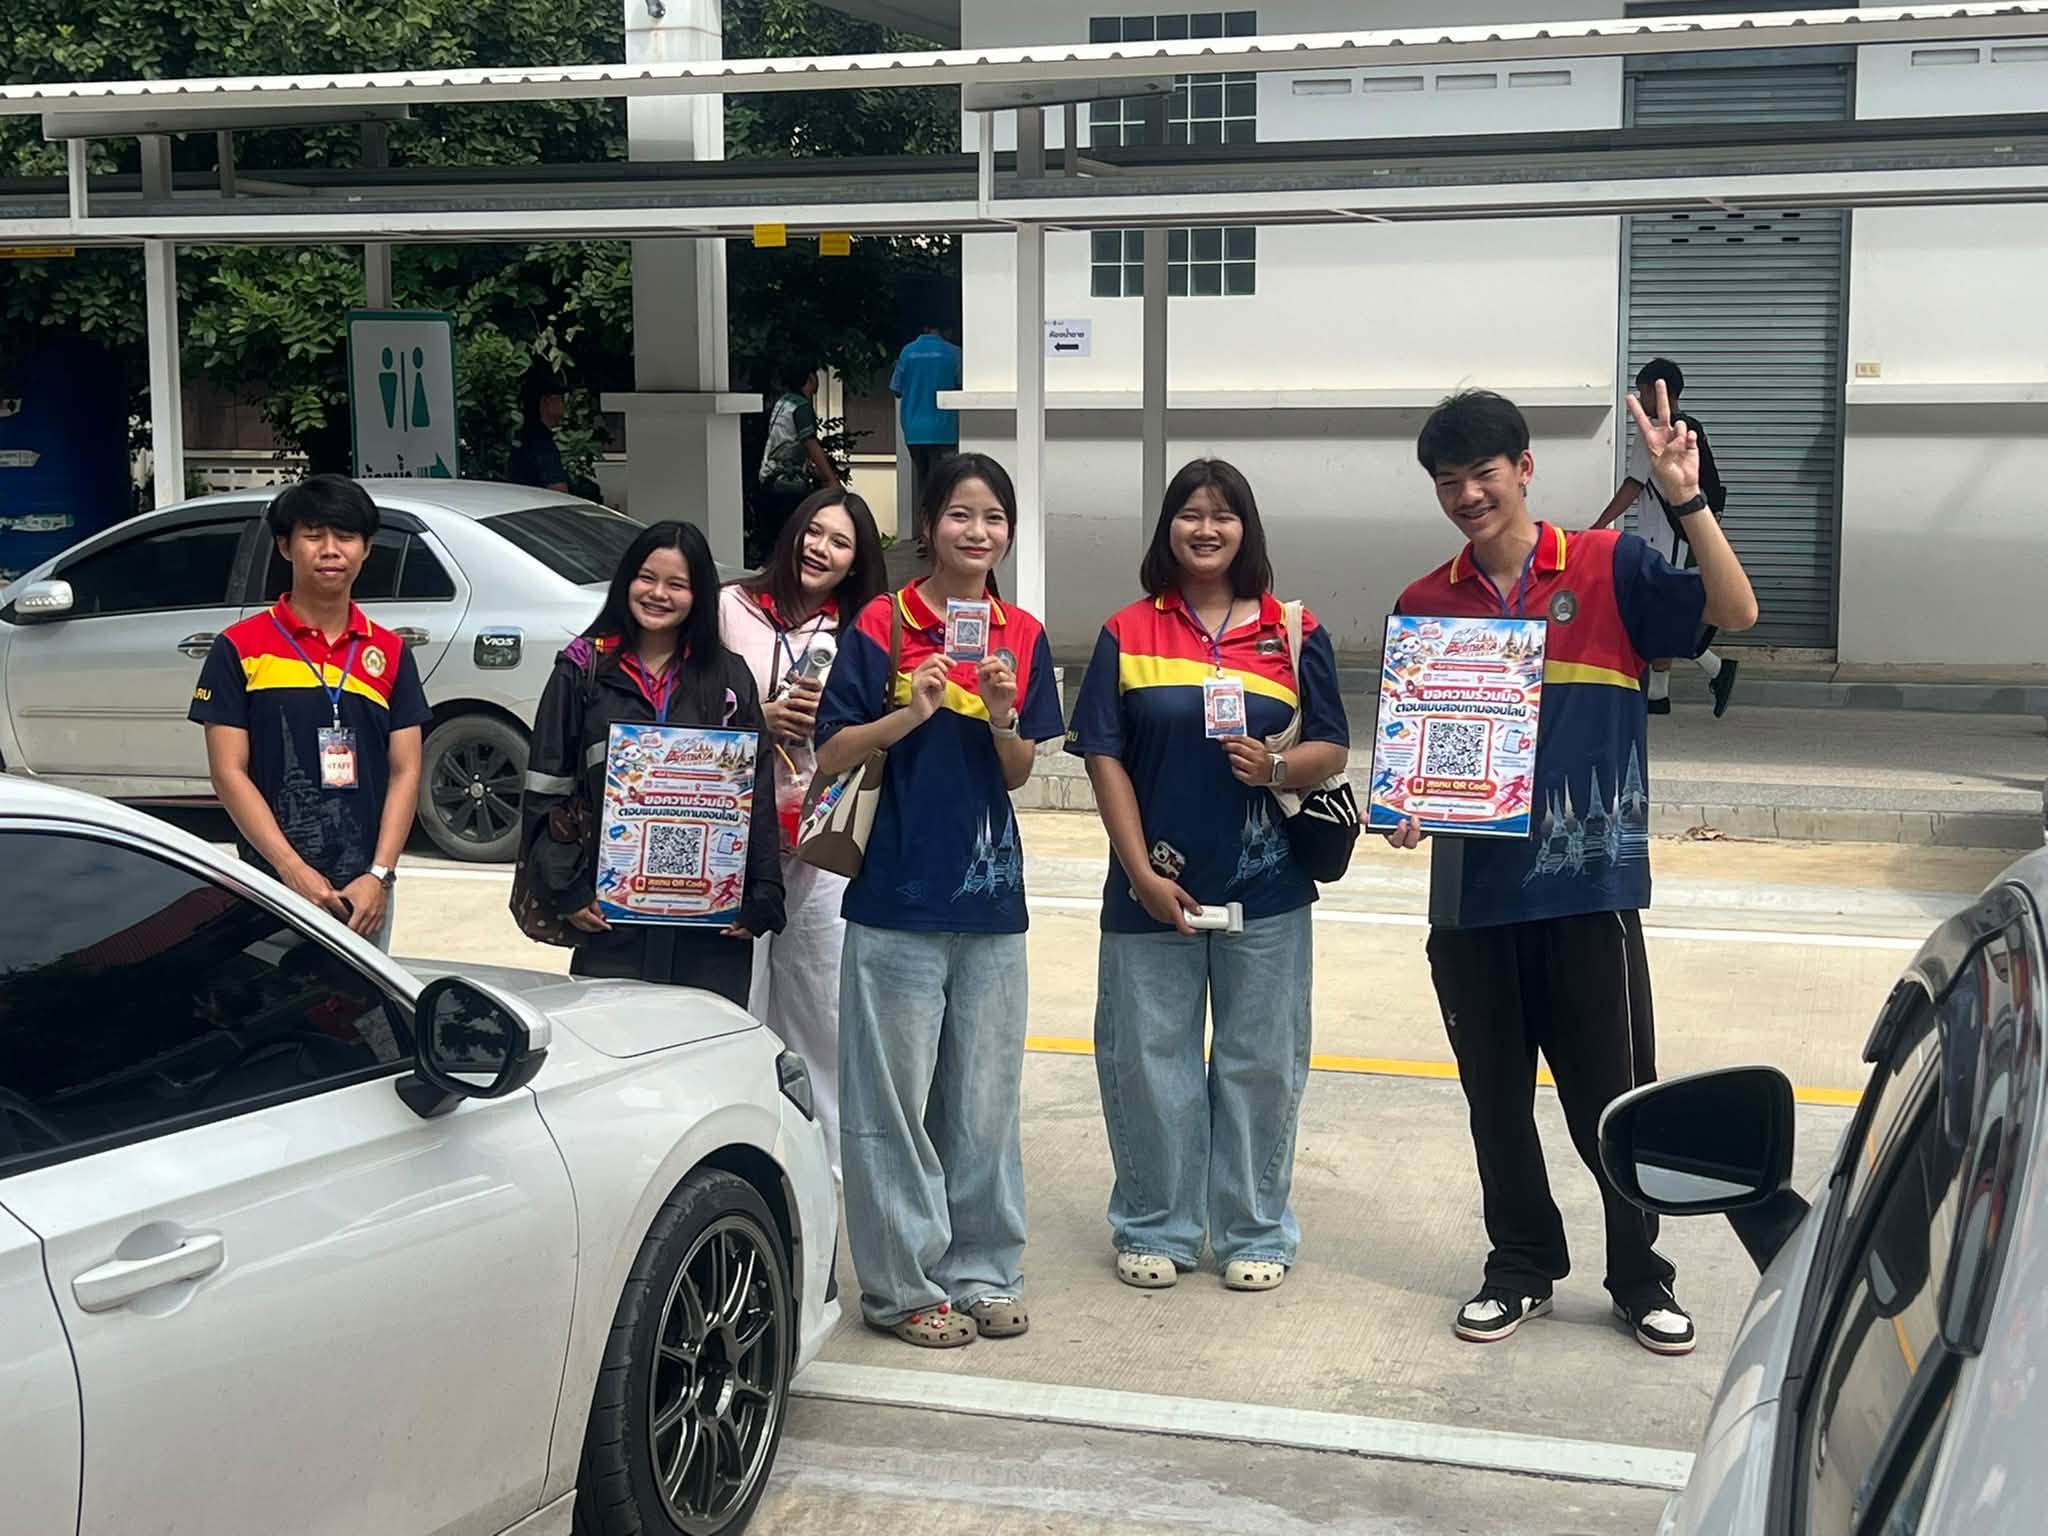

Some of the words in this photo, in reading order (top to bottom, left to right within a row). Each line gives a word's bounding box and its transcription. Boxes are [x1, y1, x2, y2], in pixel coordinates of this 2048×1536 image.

[482, 637, 515, 646] VIOS
[1423, 687, 1521, 702] ขอความร่วมมือ
[1395, 702, 1527, 716] ตอบแบบสอบถามออนไลน์
[1453, 781, 1467, 790] QR
[1468, 781, 1492, 791] Code
[686, 880, 706, 889] Code
